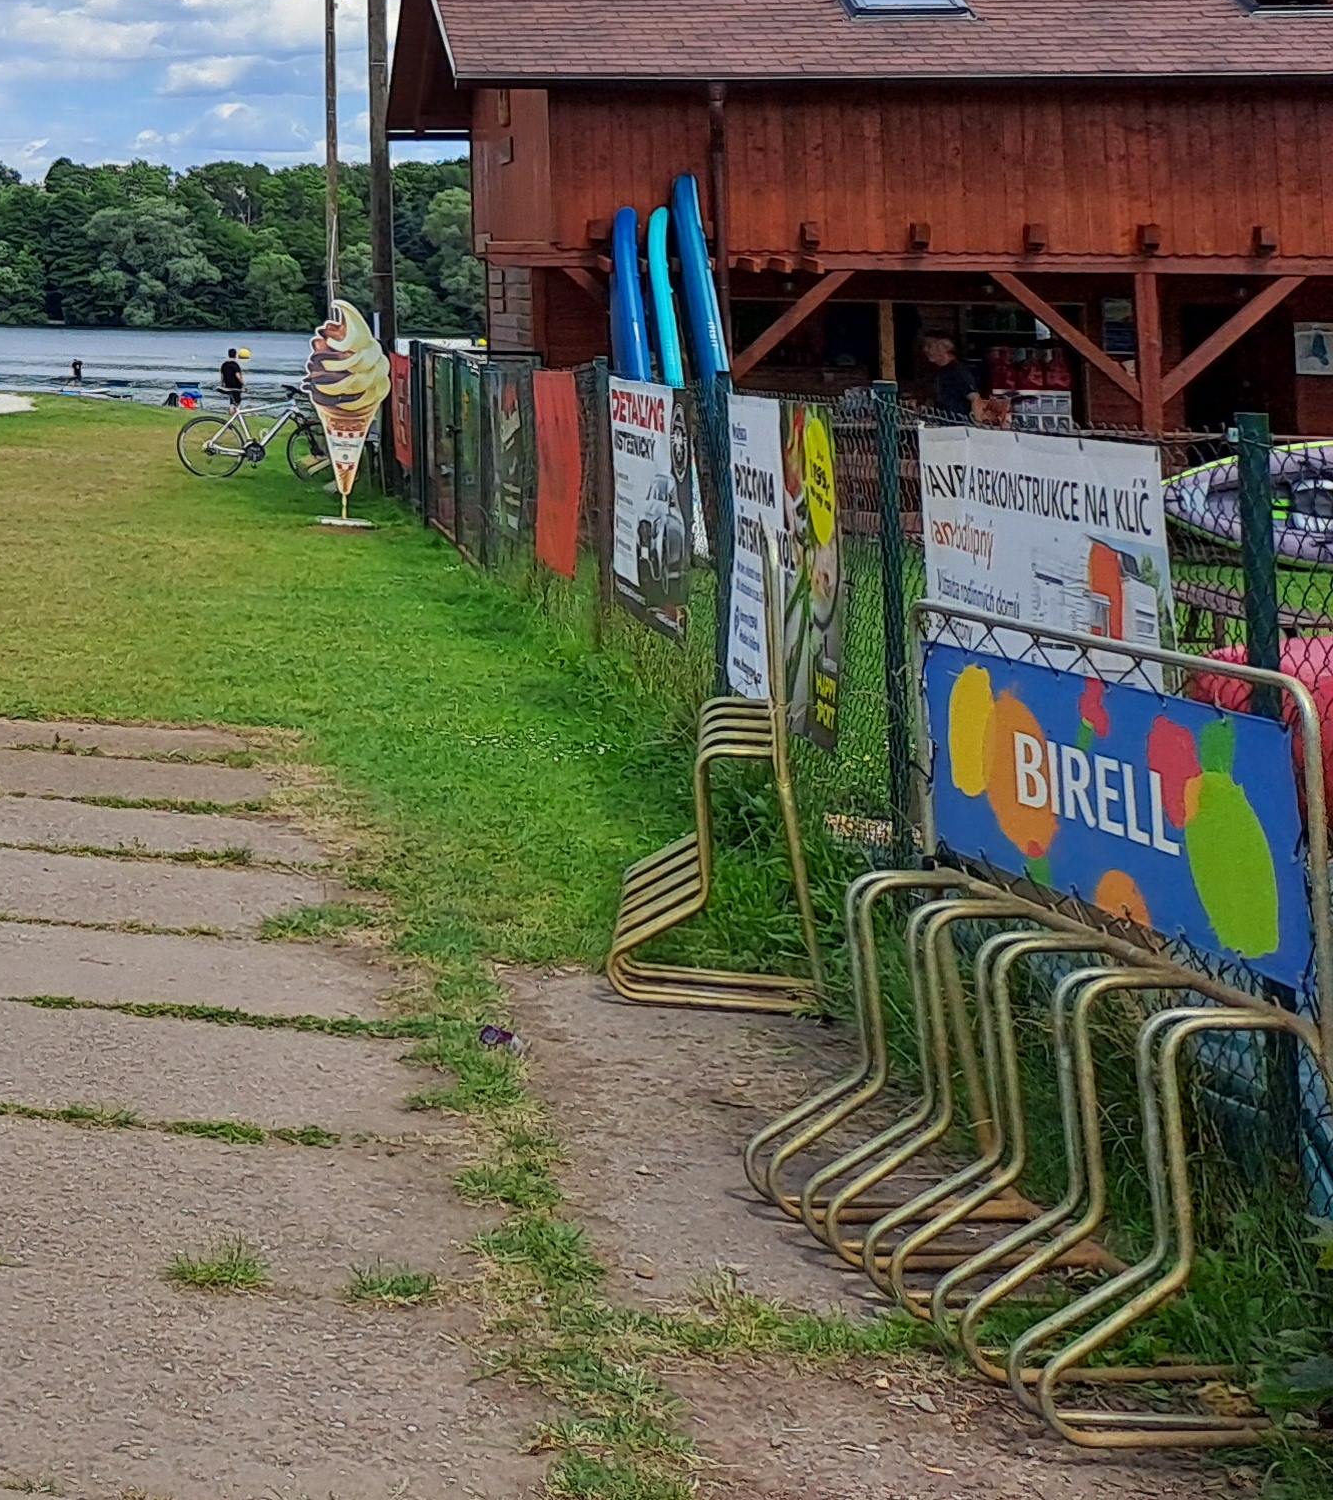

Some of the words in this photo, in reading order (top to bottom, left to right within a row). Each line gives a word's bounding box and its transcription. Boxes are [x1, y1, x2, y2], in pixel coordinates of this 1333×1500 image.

[977, 468, 1081, 522] REKONSTRUKCE
[1084, 483, 1110, 528] NA
[1113, 478, 1152, 537] KLÍČ
[1014, 731, 1181, 857] BIRELL
